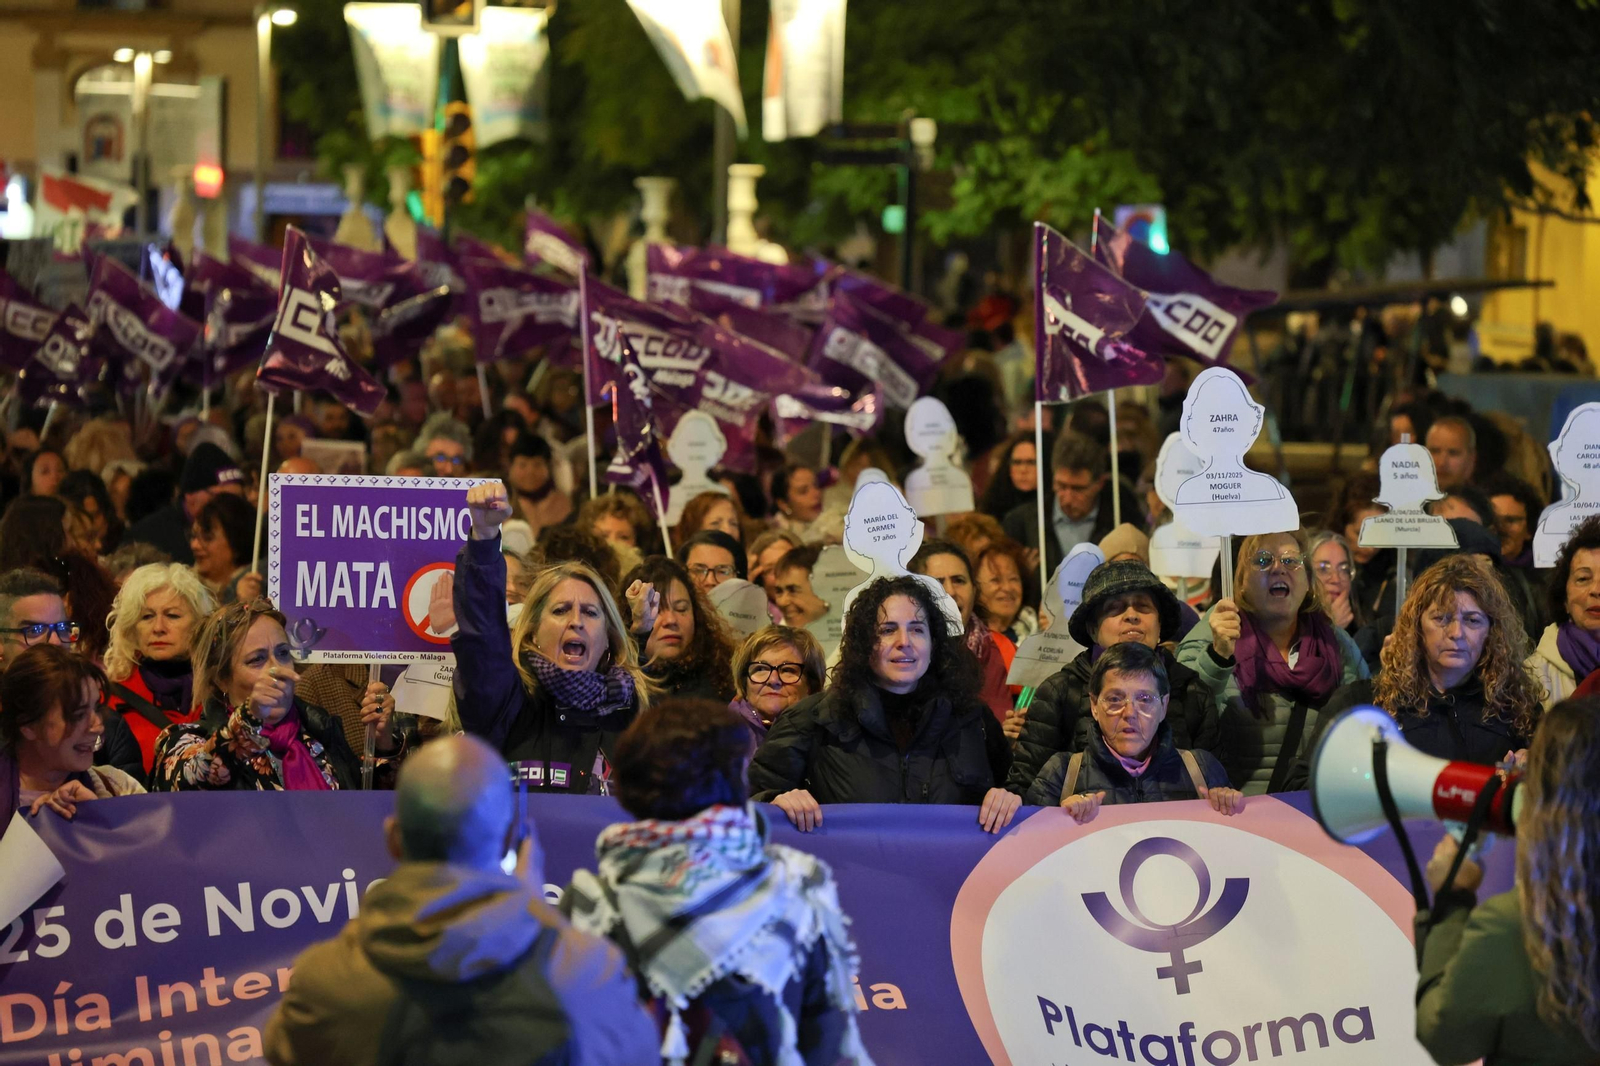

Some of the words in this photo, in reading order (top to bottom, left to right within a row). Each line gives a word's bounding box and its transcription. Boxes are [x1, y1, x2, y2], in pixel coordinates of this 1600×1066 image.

[1209, 414, 1239, 423] ZAHRA
[1205, 471, 1244, 480] 03/11/2025
[1211, 493, 1241, 501] (Huelva)
[296, 504, 325, 537] EL
[331, 505, 473, 541] MACHISMO
[863, 514, 887, 524] MARÍA
[867, 523, 896, 533] CARMEN
[872, 535, 881, 543] 57
[882, 533, 897, 541] años
[295, 561, 397, 609] MATA
[420, 653, 446, 662] Málaga
[0, 905, 71, 965] 25
[94, 893, 182, 950] de
[203, 868, 388, 937] Novi
[0, 981, 112, 1043] Día
[1036, 995, 1376, 1066] Plataforma
